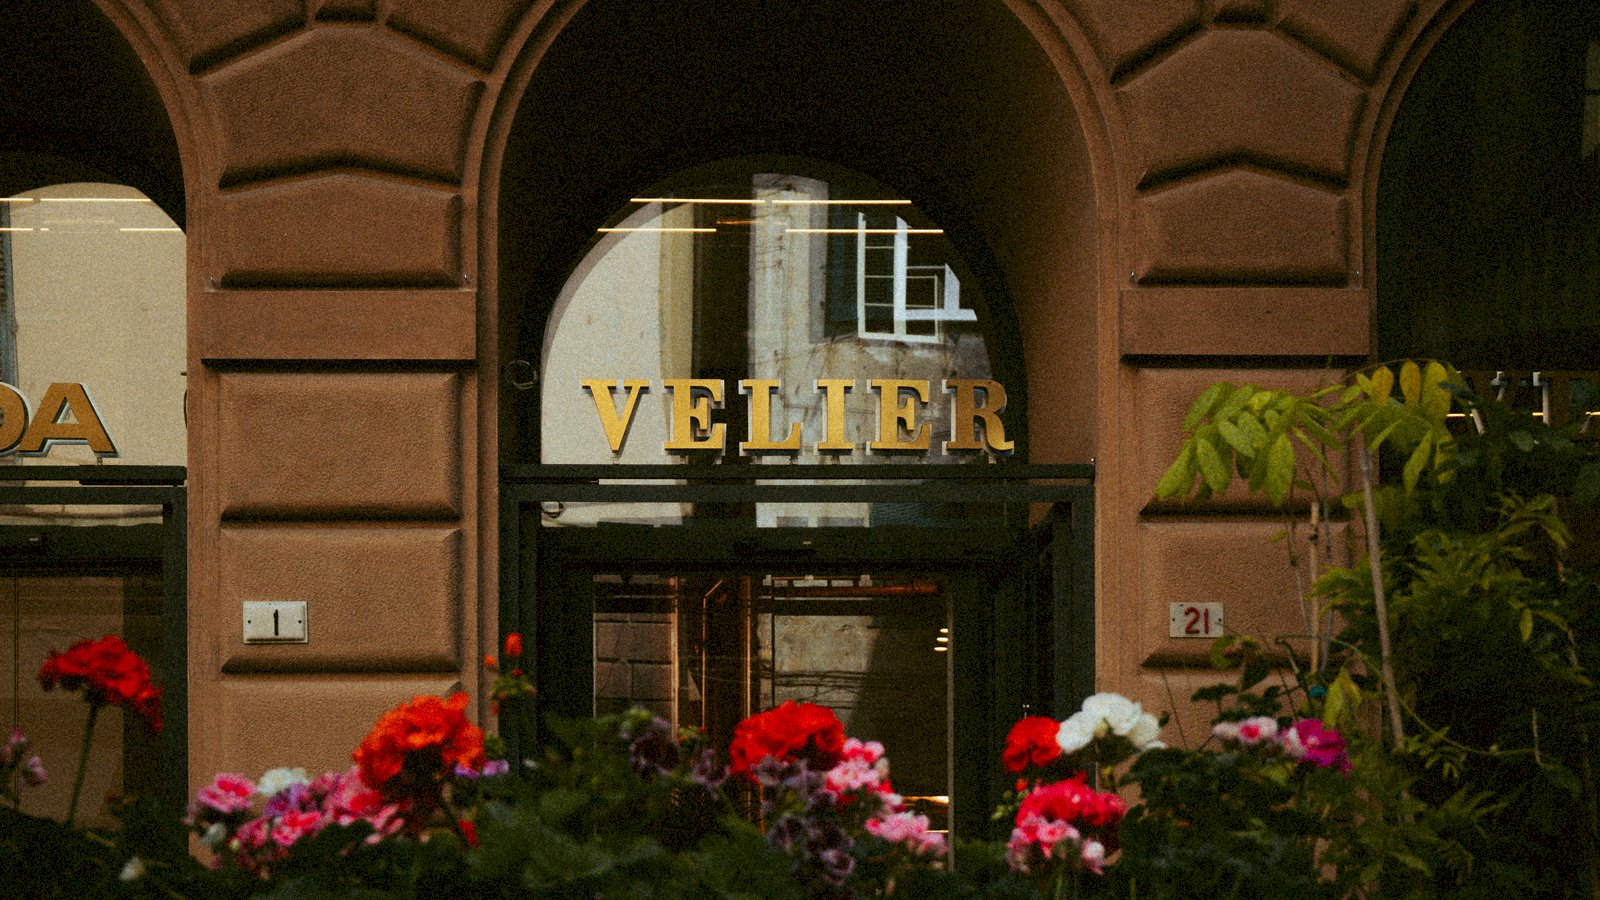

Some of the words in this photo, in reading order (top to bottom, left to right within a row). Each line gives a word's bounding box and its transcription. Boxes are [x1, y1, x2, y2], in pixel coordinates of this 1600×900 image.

[581, 378, 1015, 453] VELIER
[272, 609, 280, 636] 1
[1184, 606, 1209, 635] 21
